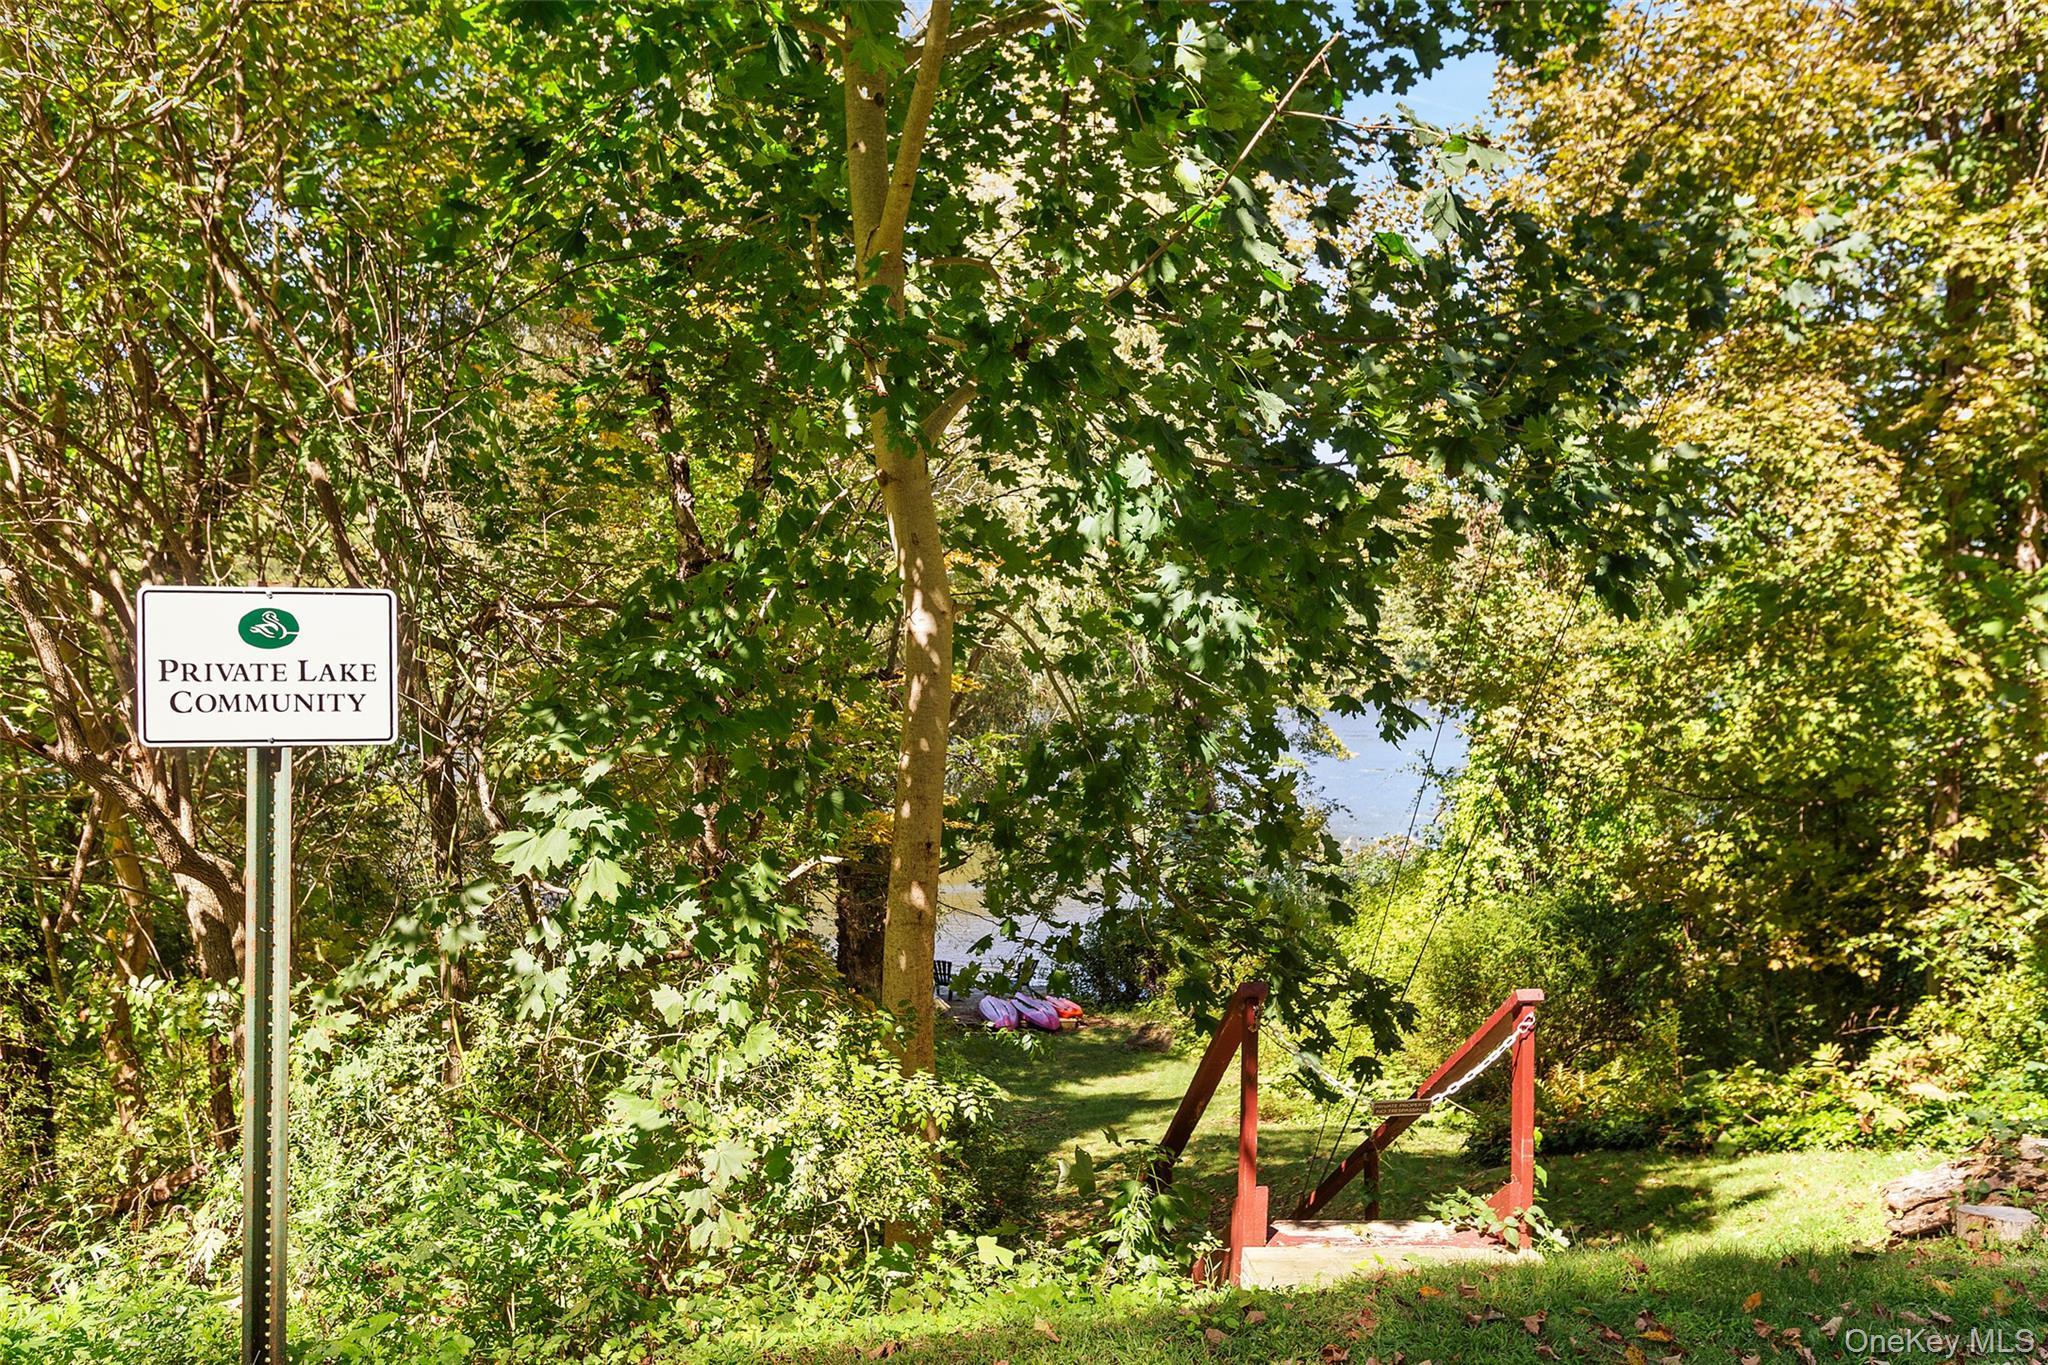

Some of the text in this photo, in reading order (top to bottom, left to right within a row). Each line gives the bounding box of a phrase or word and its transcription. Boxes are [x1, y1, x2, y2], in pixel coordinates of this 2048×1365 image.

[159, 659, 377, 682] PRIVATE LAKE
[169, 690, 366, 713] COMMUNITY
